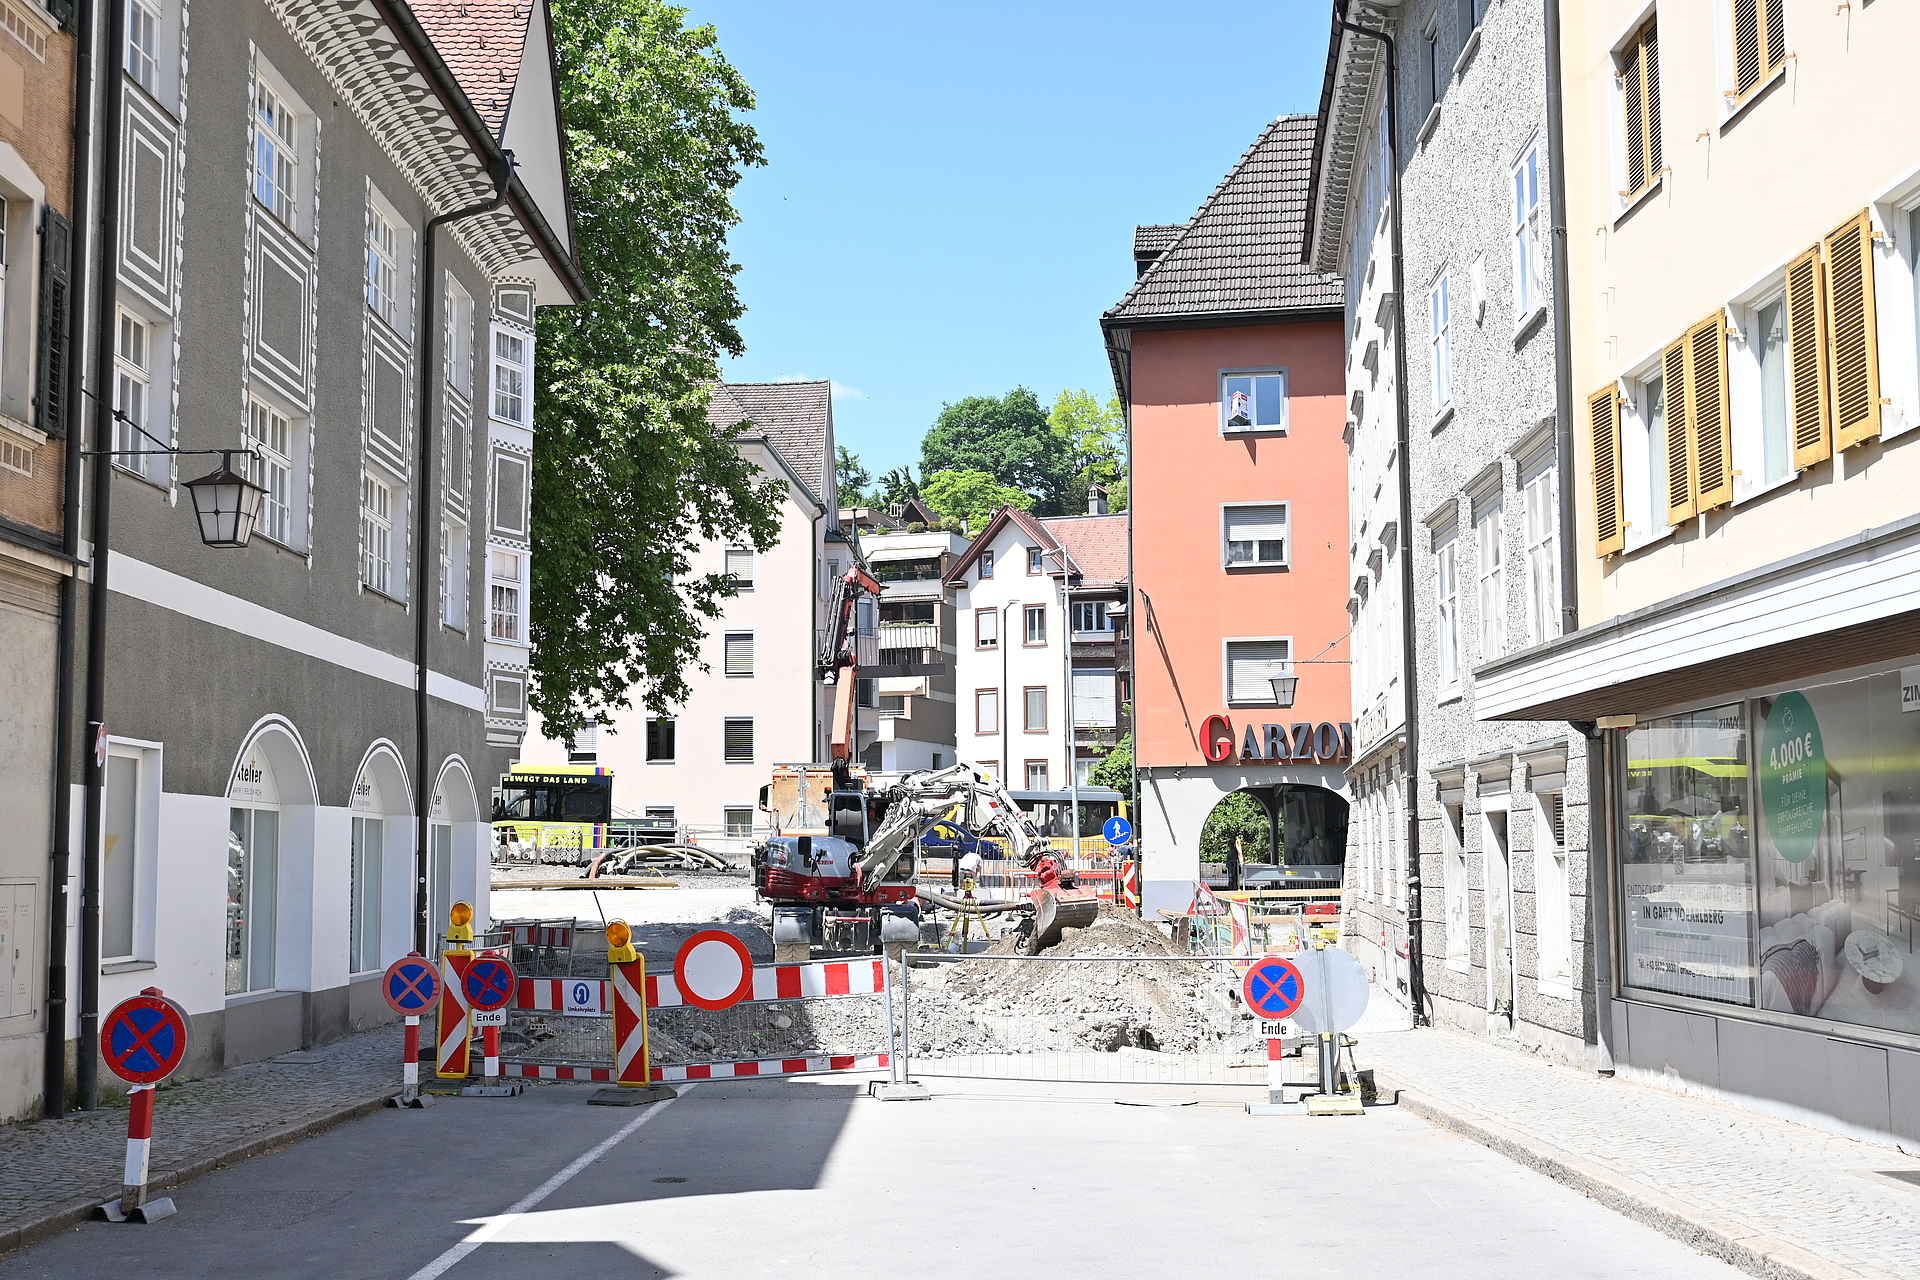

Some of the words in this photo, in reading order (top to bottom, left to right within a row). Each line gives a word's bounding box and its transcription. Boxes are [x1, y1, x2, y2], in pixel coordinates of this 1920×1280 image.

[1782, 768, 1803, 785] PRÄMIE
[1782, 794, 1791, 807] FÜR
[1791, 788, 1807, 804] DEINE
[1777, 802, 1813, 824] ERFOLGREICHE
[1779, 817, 1814, 838] EMPFEHLUNG!
[1643, 905, 1651, 919] IN
[1653, 906, 1673, 920] GANZ
[1675, 907, 1724, 924] VORARLBERG
[476, 1013, 501, 1021] Ende
[1262, 1021, 1287, 1034] Ende
